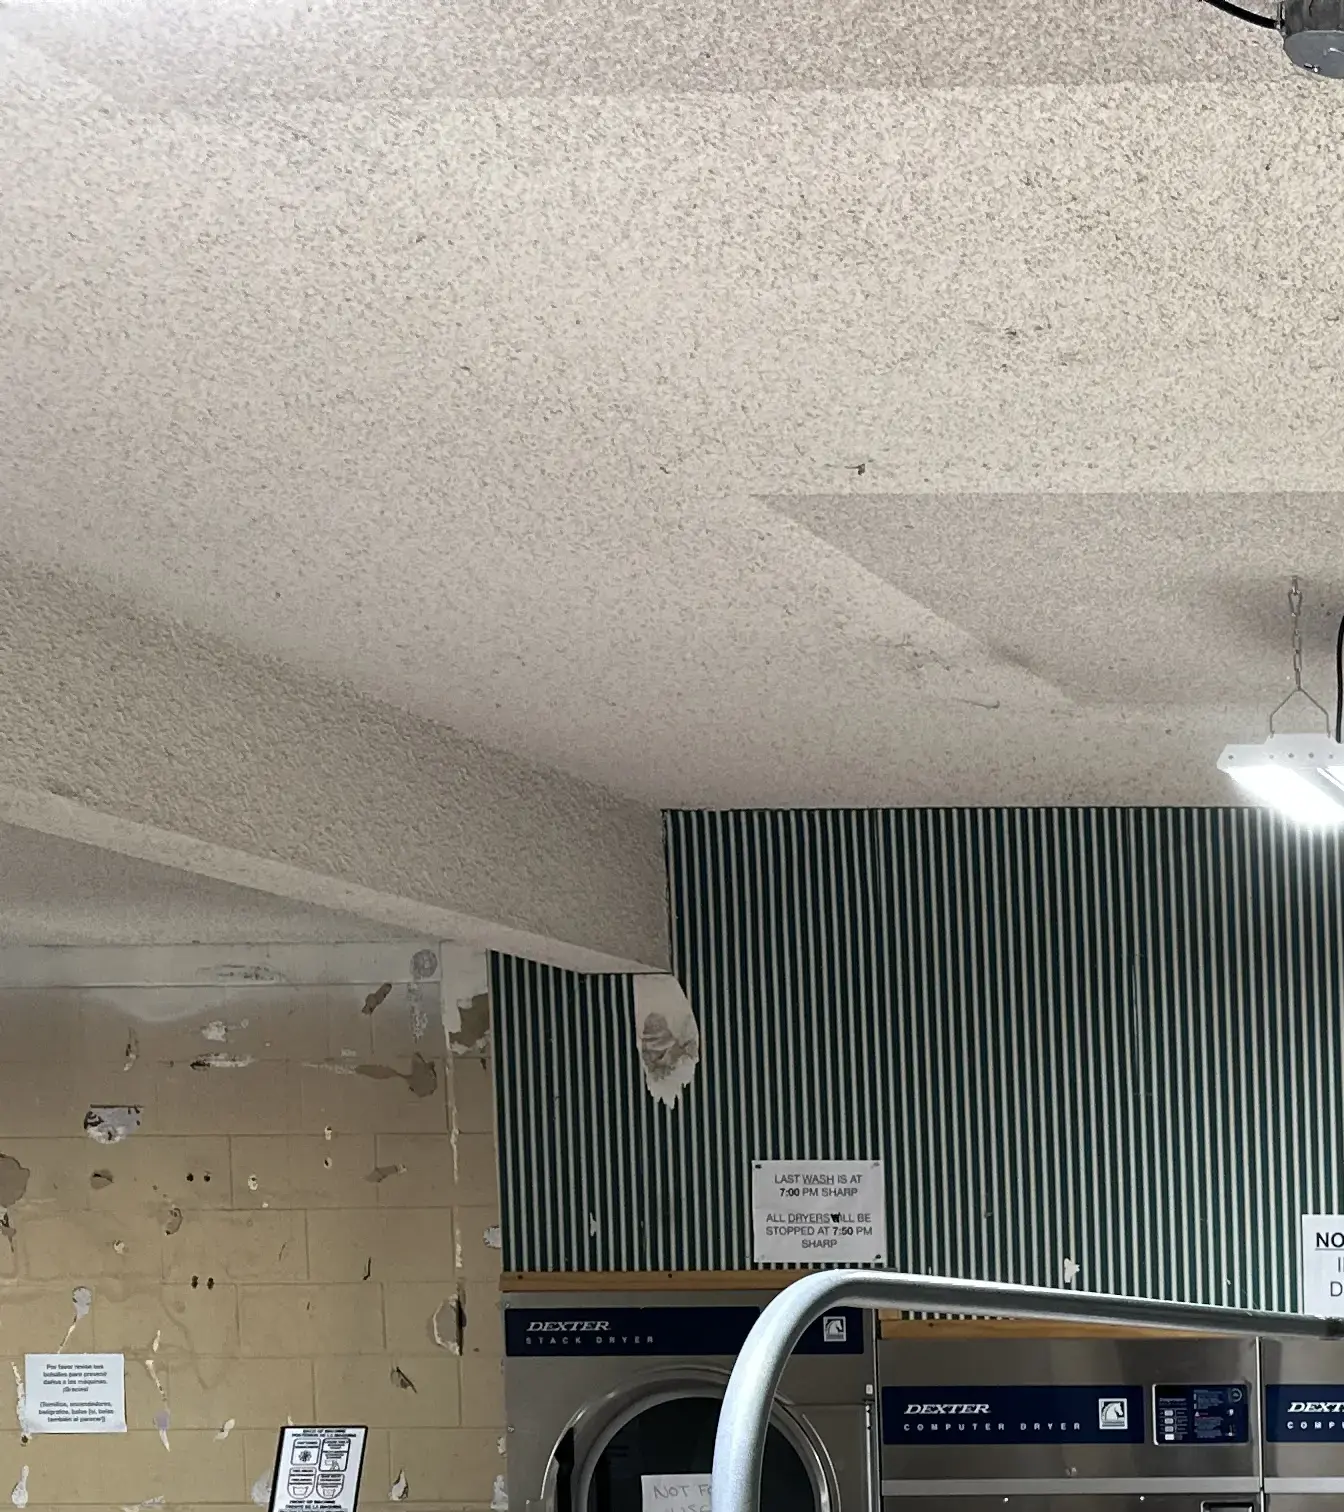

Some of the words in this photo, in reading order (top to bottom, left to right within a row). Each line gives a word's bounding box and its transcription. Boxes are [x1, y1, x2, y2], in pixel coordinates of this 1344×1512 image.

[774, 1174, 800, 1184] LAST
[802, 1174, 834, 1185] WASH
[838, 1174, 847, 1184] IS
[850, 1174, 862, 1184] AT
[780, 1188, 799, 1197] 7:00
[802, 1188, 818, 1197] PM
[821, 1188, 858, 1197] SHARP
[766, 1213, 785, 1223] ALL
[788, 1213, 830, 1224] DRYERS
[857, 1213, 871, 1222] BE
[766, 1226, 814, 1236] STOPPED
[817, 1226, 830, 1235] AT
[833, 1226, 853, 1236] 7:50
[856, 1226, 872, 1235] PM
[801, 1239, 837, 1248] SHARP
[1316, 1232, 1344, 1248] NO
[526, 1320, 611, 1332] DEXTER
[526, 1336, 581, 1344] STACK
[596, 1336, 655, 1344] DRYER
[903, 1403, 991, 1415] DEXTER
[903, 1423, 1005, 1431] COMPUTER
[1020, 1422, 1081, 1431] DRYER
[653, 1485, 689, 1499] NOT
